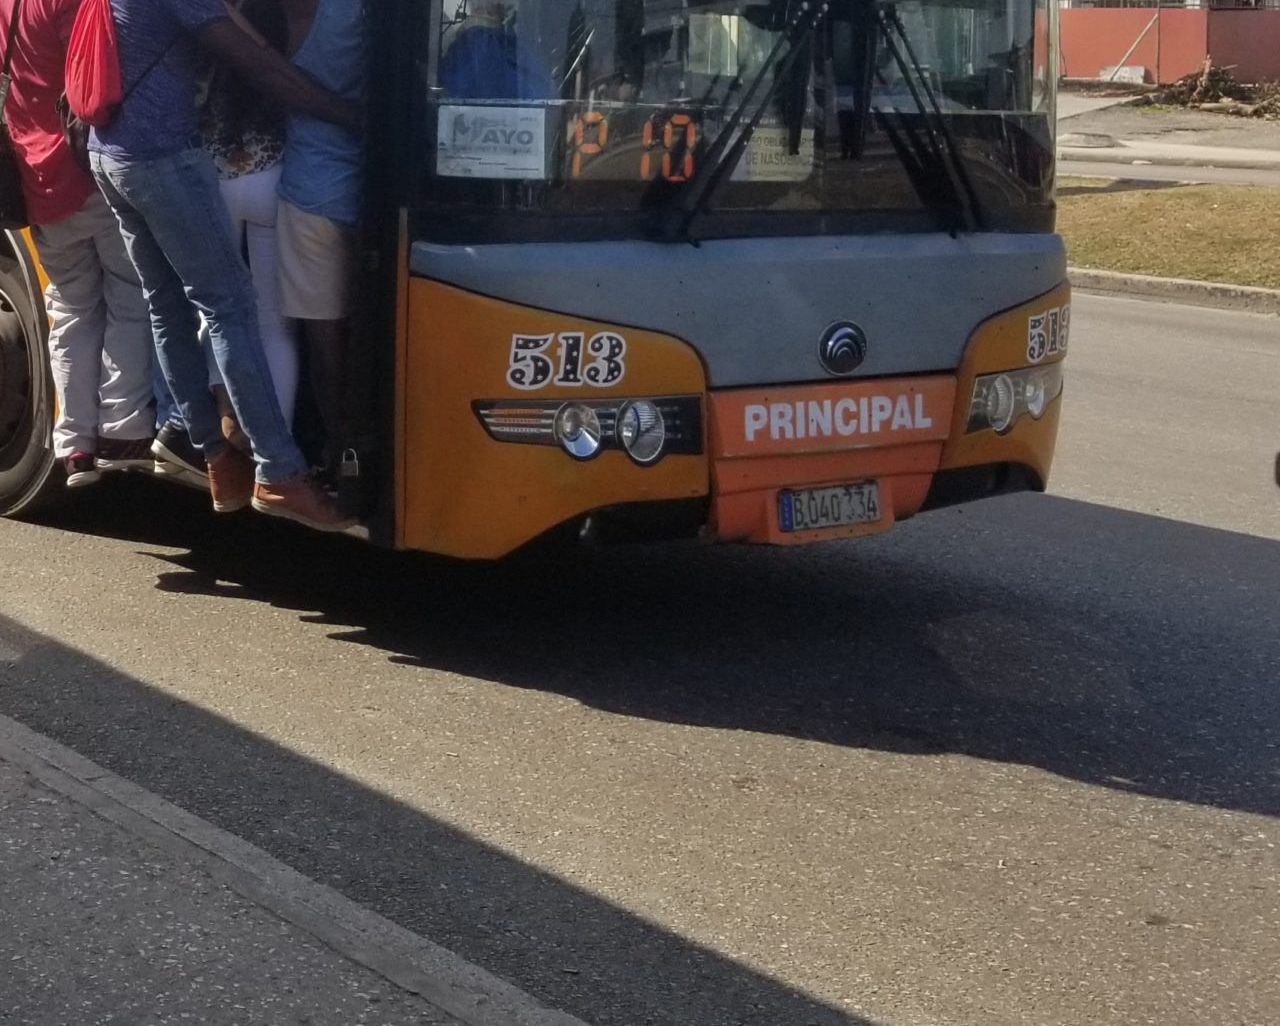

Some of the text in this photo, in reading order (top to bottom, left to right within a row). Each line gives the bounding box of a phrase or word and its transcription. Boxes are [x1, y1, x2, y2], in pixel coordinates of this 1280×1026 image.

[640, 114, 696, 182] 10
[506, 331, 627, 390] 513
[744, 393, 933, 442] PRINCIPAL
